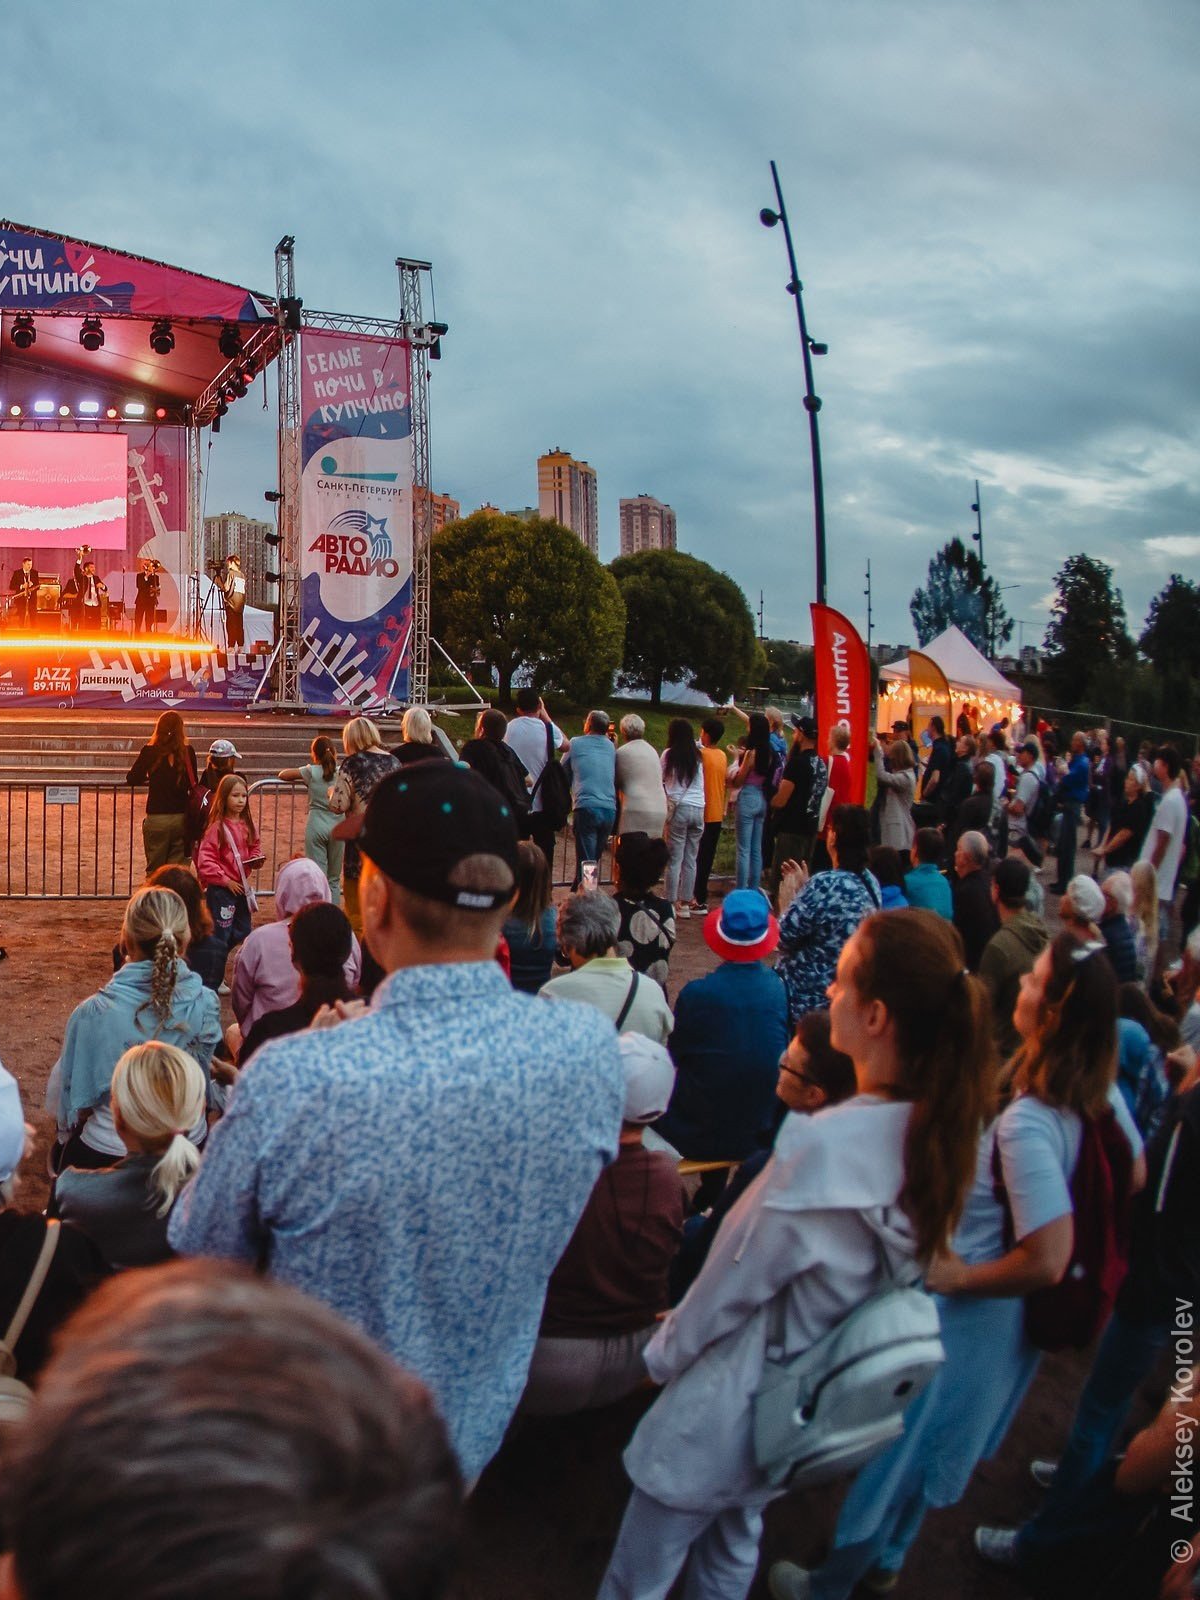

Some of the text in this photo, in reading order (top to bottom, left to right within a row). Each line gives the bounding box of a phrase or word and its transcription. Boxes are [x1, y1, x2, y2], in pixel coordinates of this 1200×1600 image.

[306, 347, 363, 375] БЕЛЫЕ
[313, 368, 384, 398] НОЧИ В
[320, 391, 408, 423] КУПЧИНО
[308, 533, 368, 556] АВТО
[325, 554, 399, 578] РАДИО
[33, 667, 71, 680] JAZZ
[81, 675, 130, 685] ДНЕВНИК
[33, 681, 71, 691] 89.1 FM
